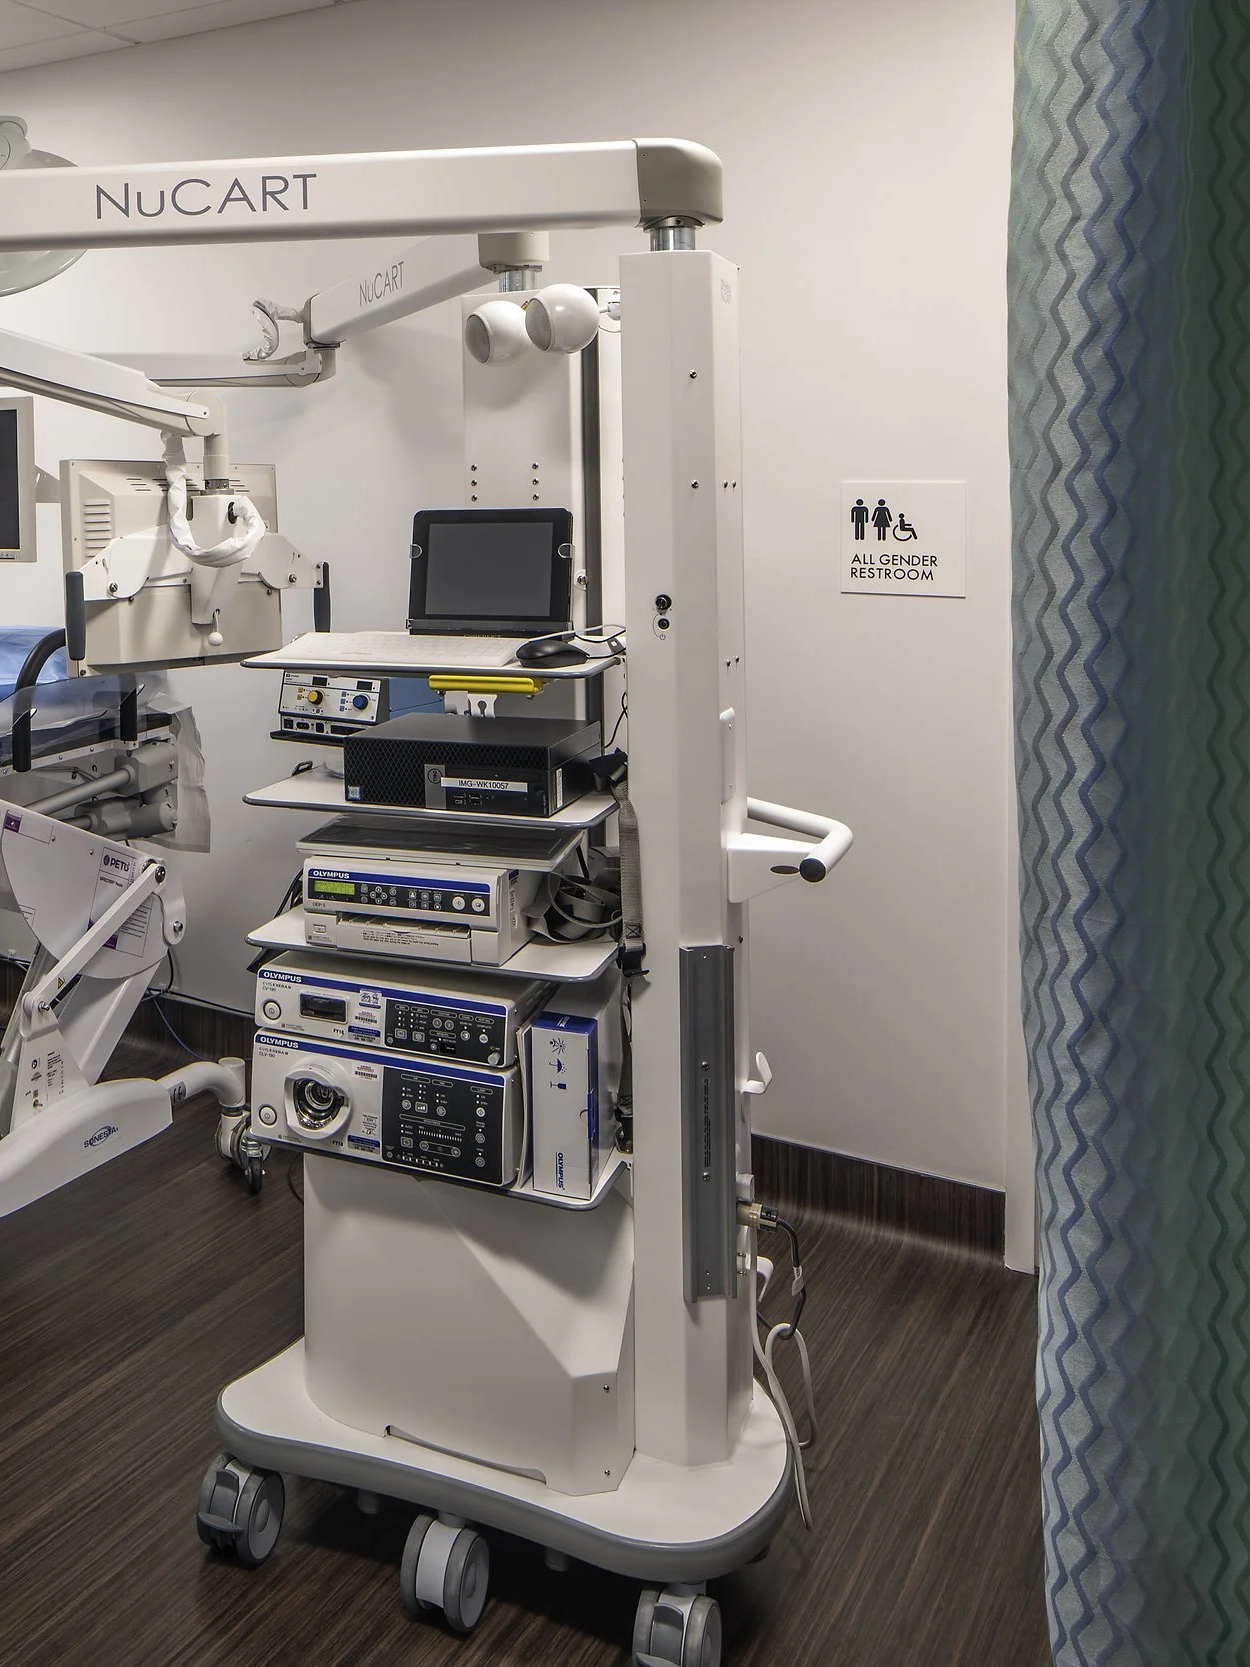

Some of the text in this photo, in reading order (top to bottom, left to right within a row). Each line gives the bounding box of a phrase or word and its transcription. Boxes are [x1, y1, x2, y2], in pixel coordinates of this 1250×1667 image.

[96, 173, 317, 220] NuCART
[359, 261, 404, 307] NuCART
[851, 553, 938, 567] ALL GENDER
[850, 567, 934, 581] RESTROOM
[458, 779, 509, 790] IMG-WK10057
[313, 870, 350, 879] OLYMPUS
[263, 971, 302, 983] OLYMPUS
[260, 1036, 299, 1049] OLYMPUS
